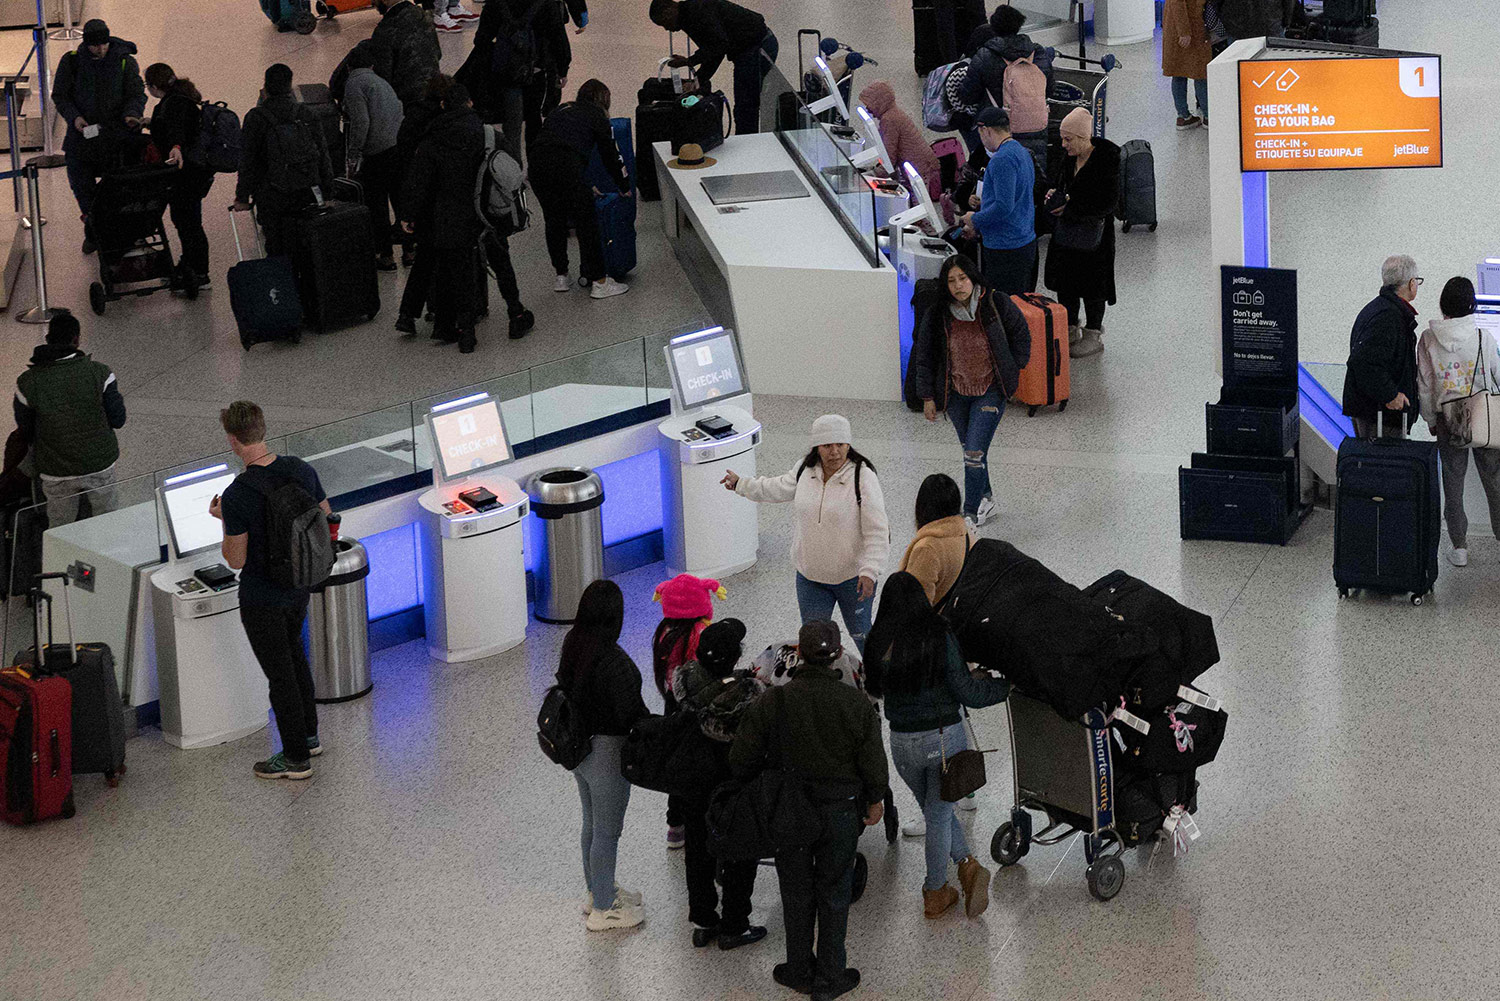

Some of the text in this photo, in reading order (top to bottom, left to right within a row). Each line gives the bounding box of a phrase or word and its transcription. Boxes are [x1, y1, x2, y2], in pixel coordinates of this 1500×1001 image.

[1414, 67, 1425, 87] 1
[1254, 104, 1310, 116] CHECK-IN
[1254, 115, 1335, 127] TAG YOUR BAG
[1255, 139, 1300, 148] CHECK-IN
[1255, 148, 1363, 159] ETIQUETE SU EQUIPAJE
[1393, 144, 1429, 157] jetBlue
[1233, 277, 1254, 285] jetBlue
[1252, 311, 1262, 319] get
[1259, 320, 1278, 328] away.
[687, 367, 733, 391] CHECK-IN
[464, 414, 472, 434] 1
[448, 434, 498, 458] CHECK-IN
